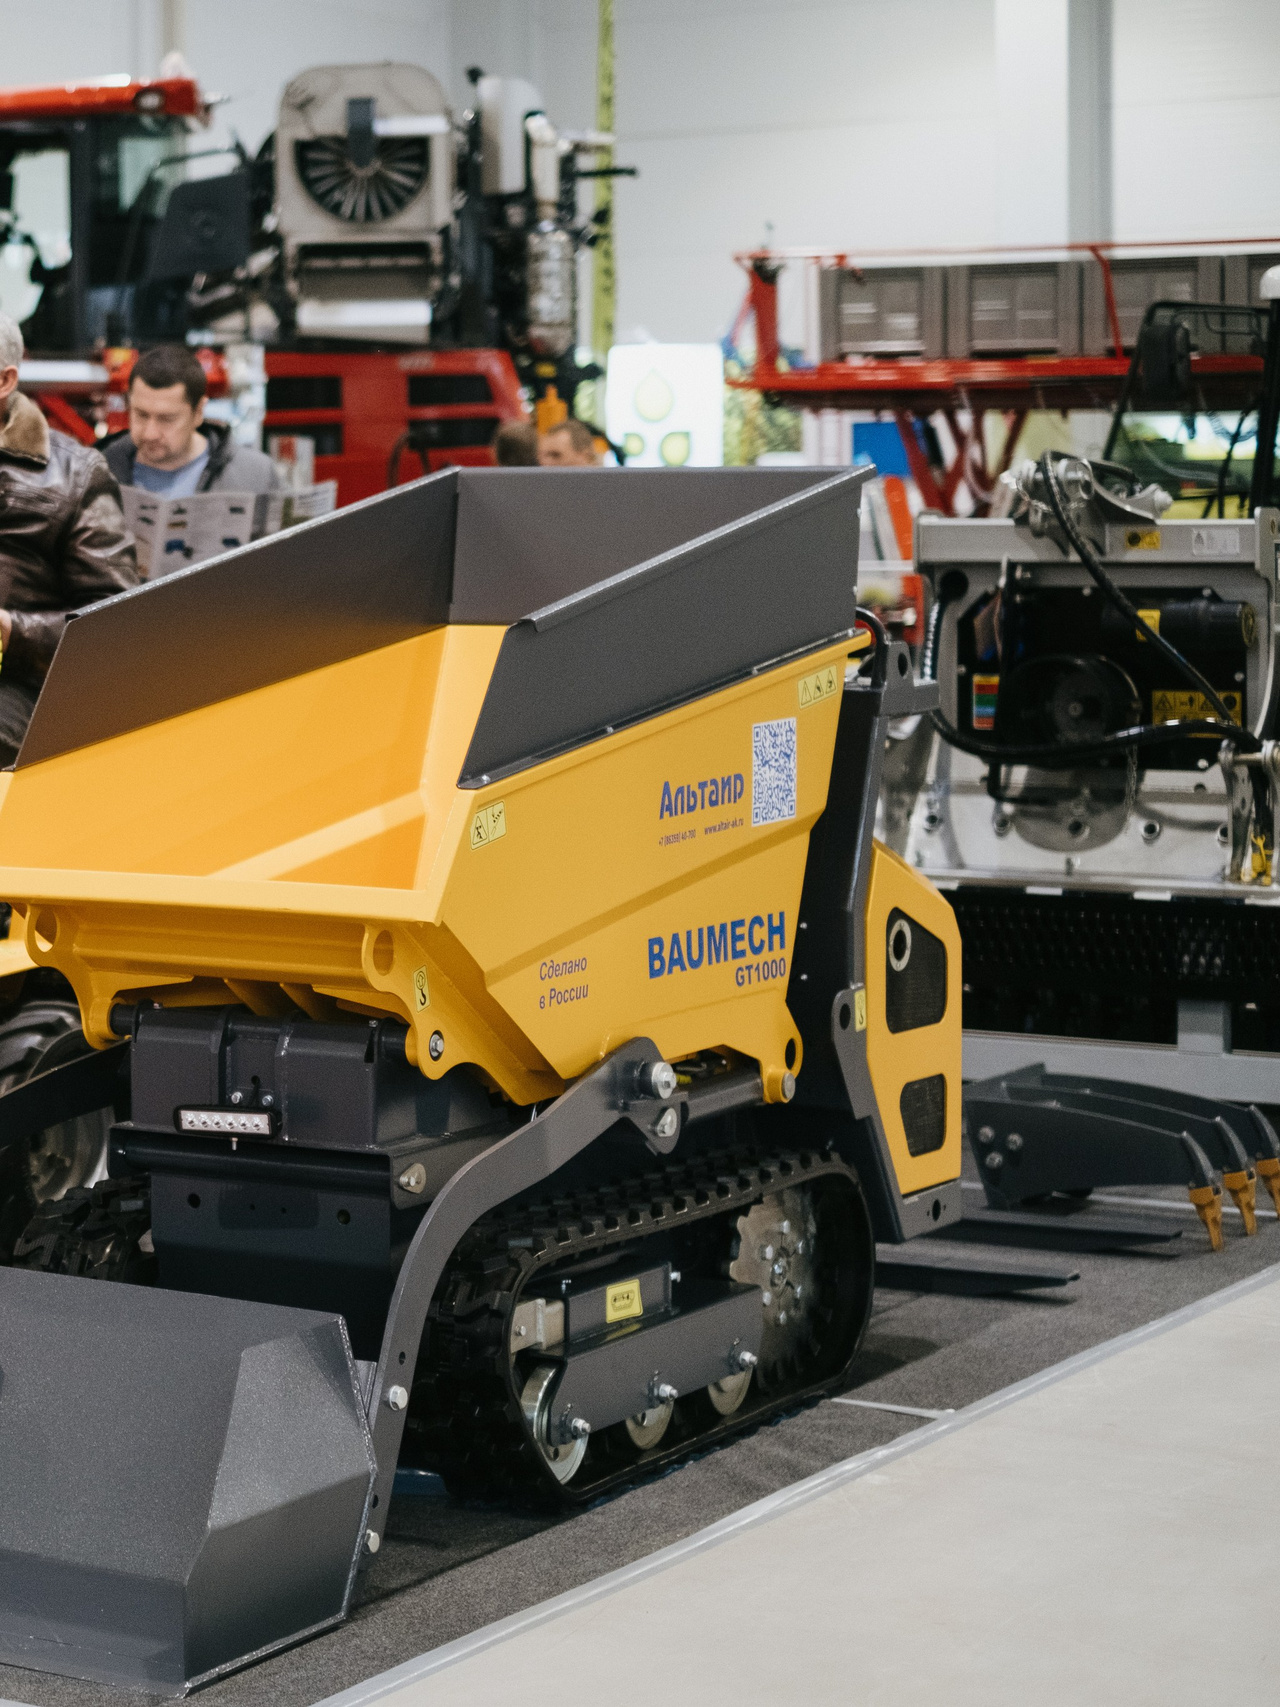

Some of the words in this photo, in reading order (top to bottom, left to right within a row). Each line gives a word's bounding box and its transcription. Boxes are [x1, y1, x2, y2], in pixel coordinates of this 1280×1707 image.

[659, 773, 745, 820] Альтаир
[648, 911, 787, 980] BAUMECH
[539, 957, 588, 981] Сделано
[735, 957, 787, 988] GT1000
[539, 995, 546, 1010] в
[548, 984, 589, 1008] России
